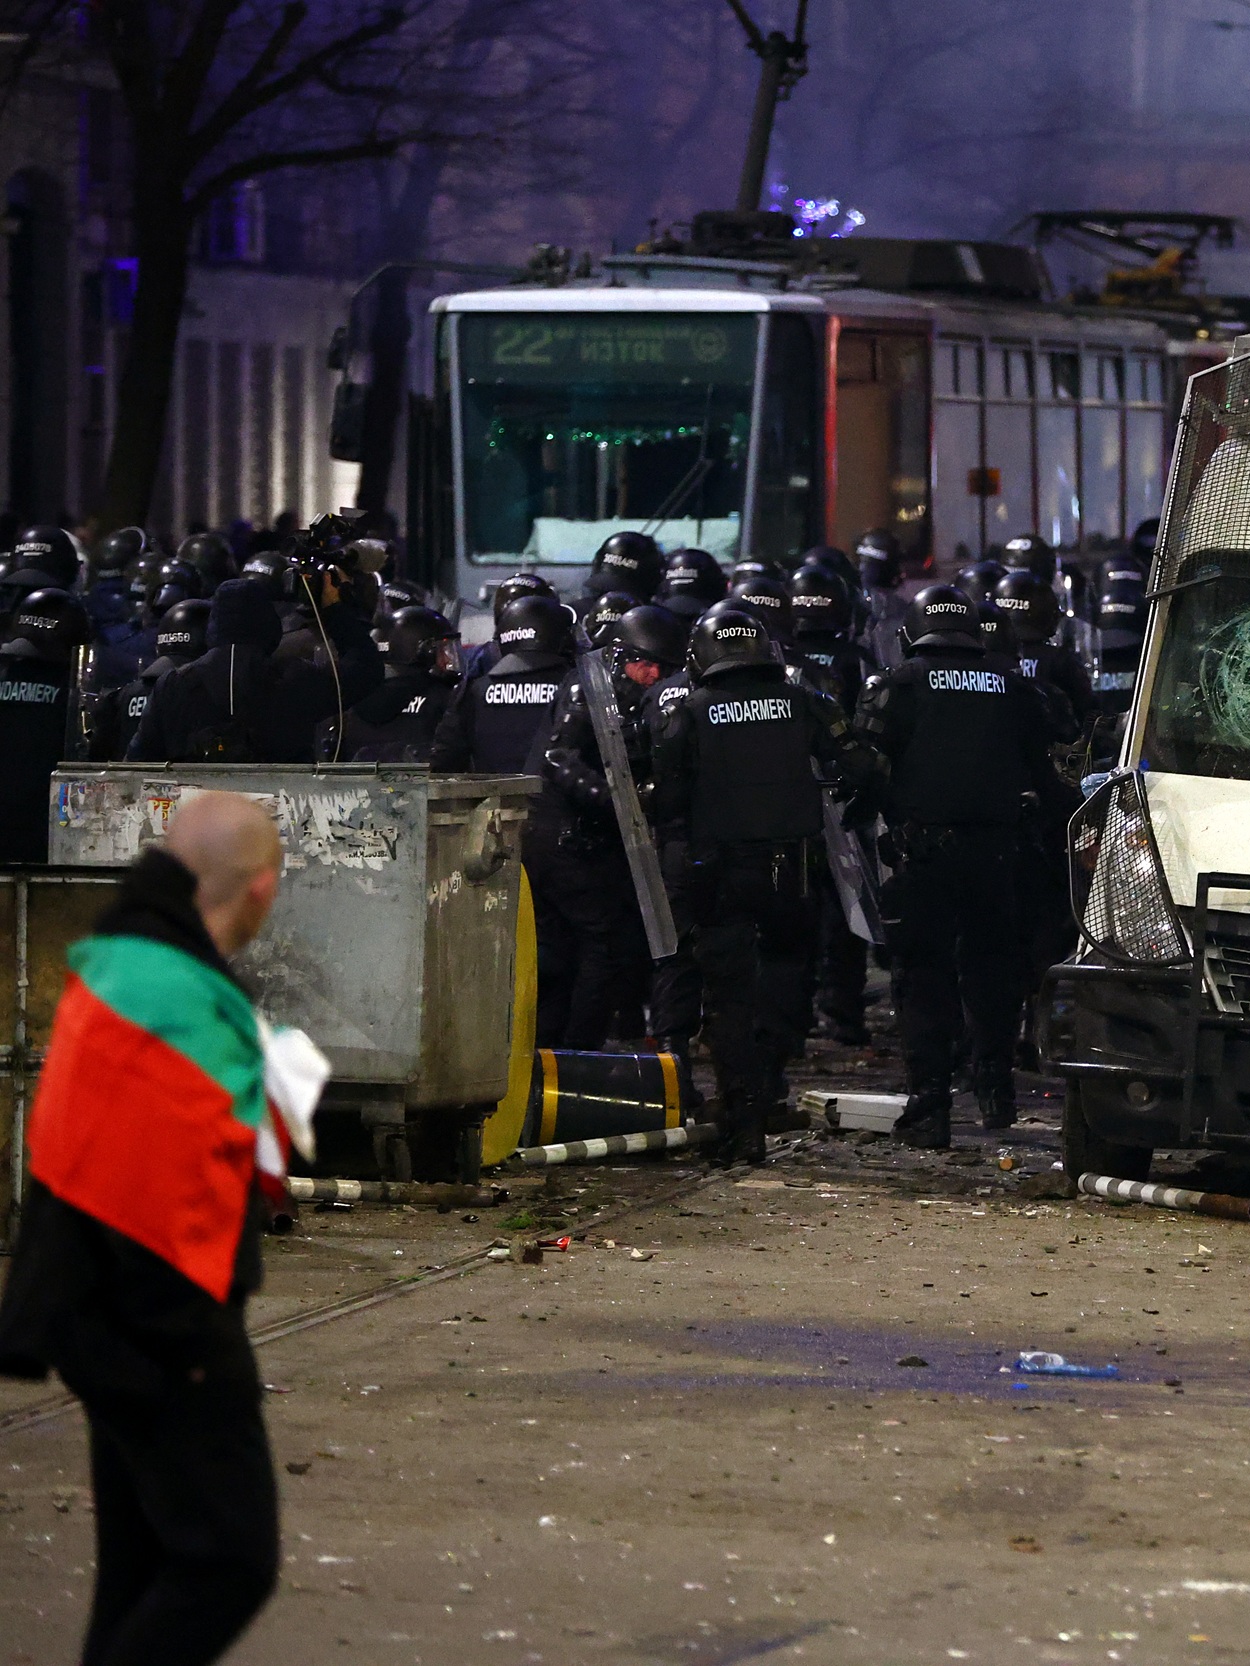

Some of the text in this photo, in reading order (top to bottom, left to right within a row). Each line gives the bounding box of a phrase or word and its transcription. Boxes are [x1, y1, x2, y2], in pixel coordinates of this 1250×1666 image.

[493, 326, 552, 364] 22
[926, 603, 967, 615] 3007037
[716, 627, 757, 640] 3007117
[928, 669, 1006, 694] GENDARMERY
[485, 683, 558, 704] GENDARMER
[708, 698, 792, 725] GENDARMERY
